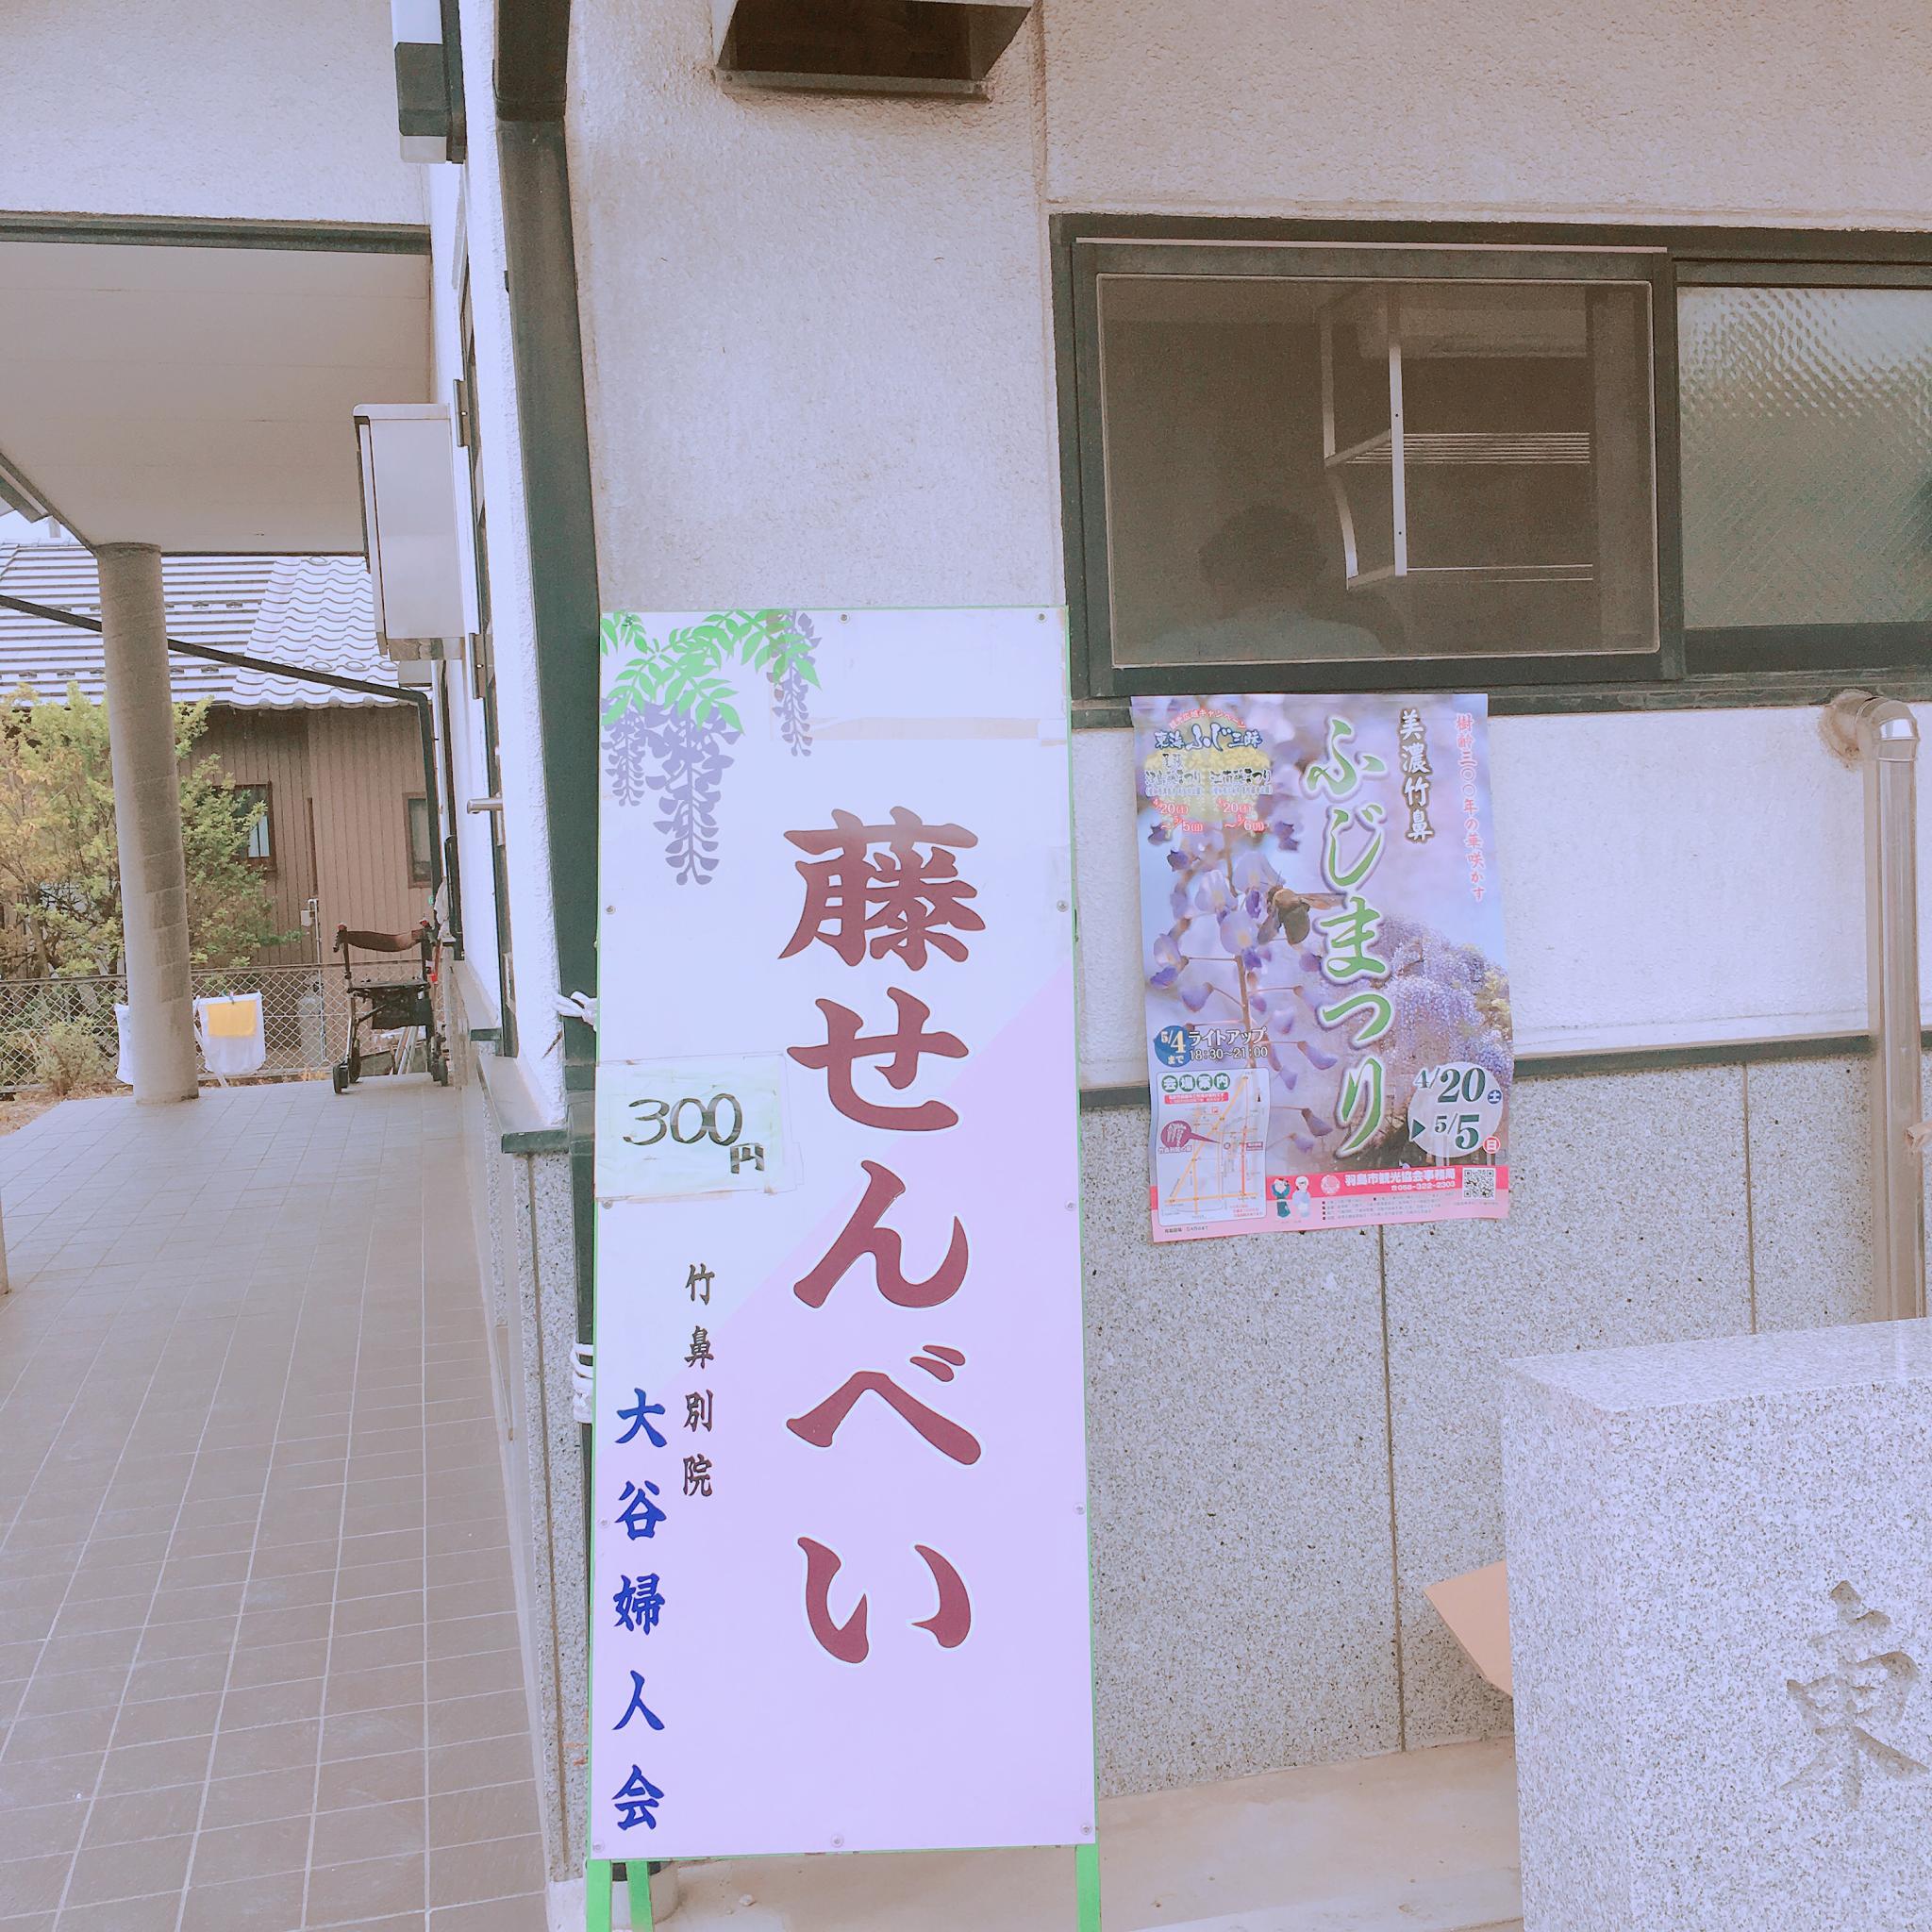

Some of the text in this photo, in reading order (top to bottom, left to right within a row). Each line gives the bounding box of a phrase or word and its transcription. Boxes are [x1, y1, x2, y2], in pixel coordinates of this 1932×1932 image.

[1400, 708, 1434, 841] 美濃竹鼻
[1305, 716, 1393, 1155] ふじまつり
[1160, 1030, 1187, 1054] 5/4
[1168, 1055, 1184, 1065] まで
[1189, 1026, 1267, 1047] ライトアップ
[1414, 1067, 1486, 1103] 4/20
[622, 1091, 766, 1175] 300円
[1435, 1113, 1479, 1150] 5/5
[777, 806, 987, 1664] 藤せんべい
[681, 1261, 716, 1498] 竹鼻別院
[610, 1387, 669, 1831] 大谷婦人会
[1779, 1579, 1930, 1811] 東
